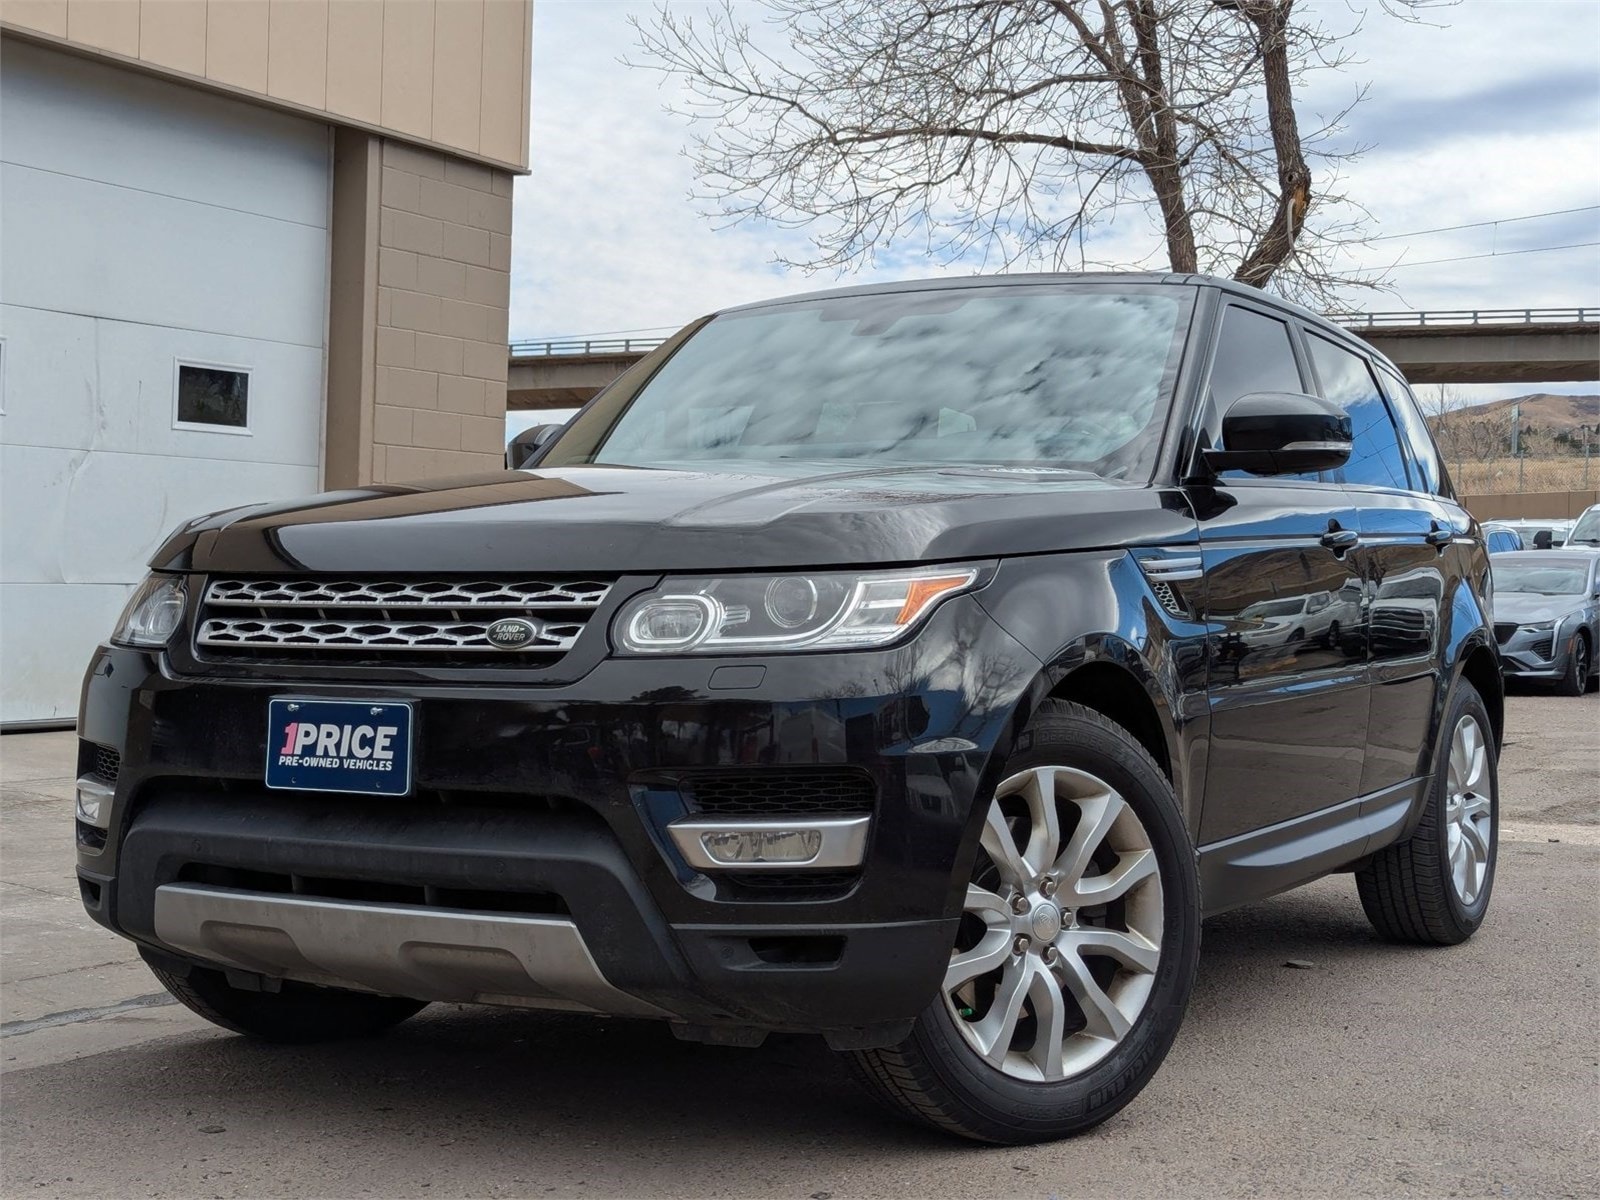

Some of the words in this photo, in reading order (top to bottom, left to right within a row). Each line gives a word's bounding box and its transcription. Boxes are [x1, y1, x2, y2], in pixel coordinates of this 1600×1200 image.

[496, 624, 519, 633] LAND
[496, 632, 525, 641] ROVER
[280, 722, 398, 760] 1PRICE
[278, 755, 340, 769] PRE-OWNED
[343, 758, 393, 771] VEHICLES
